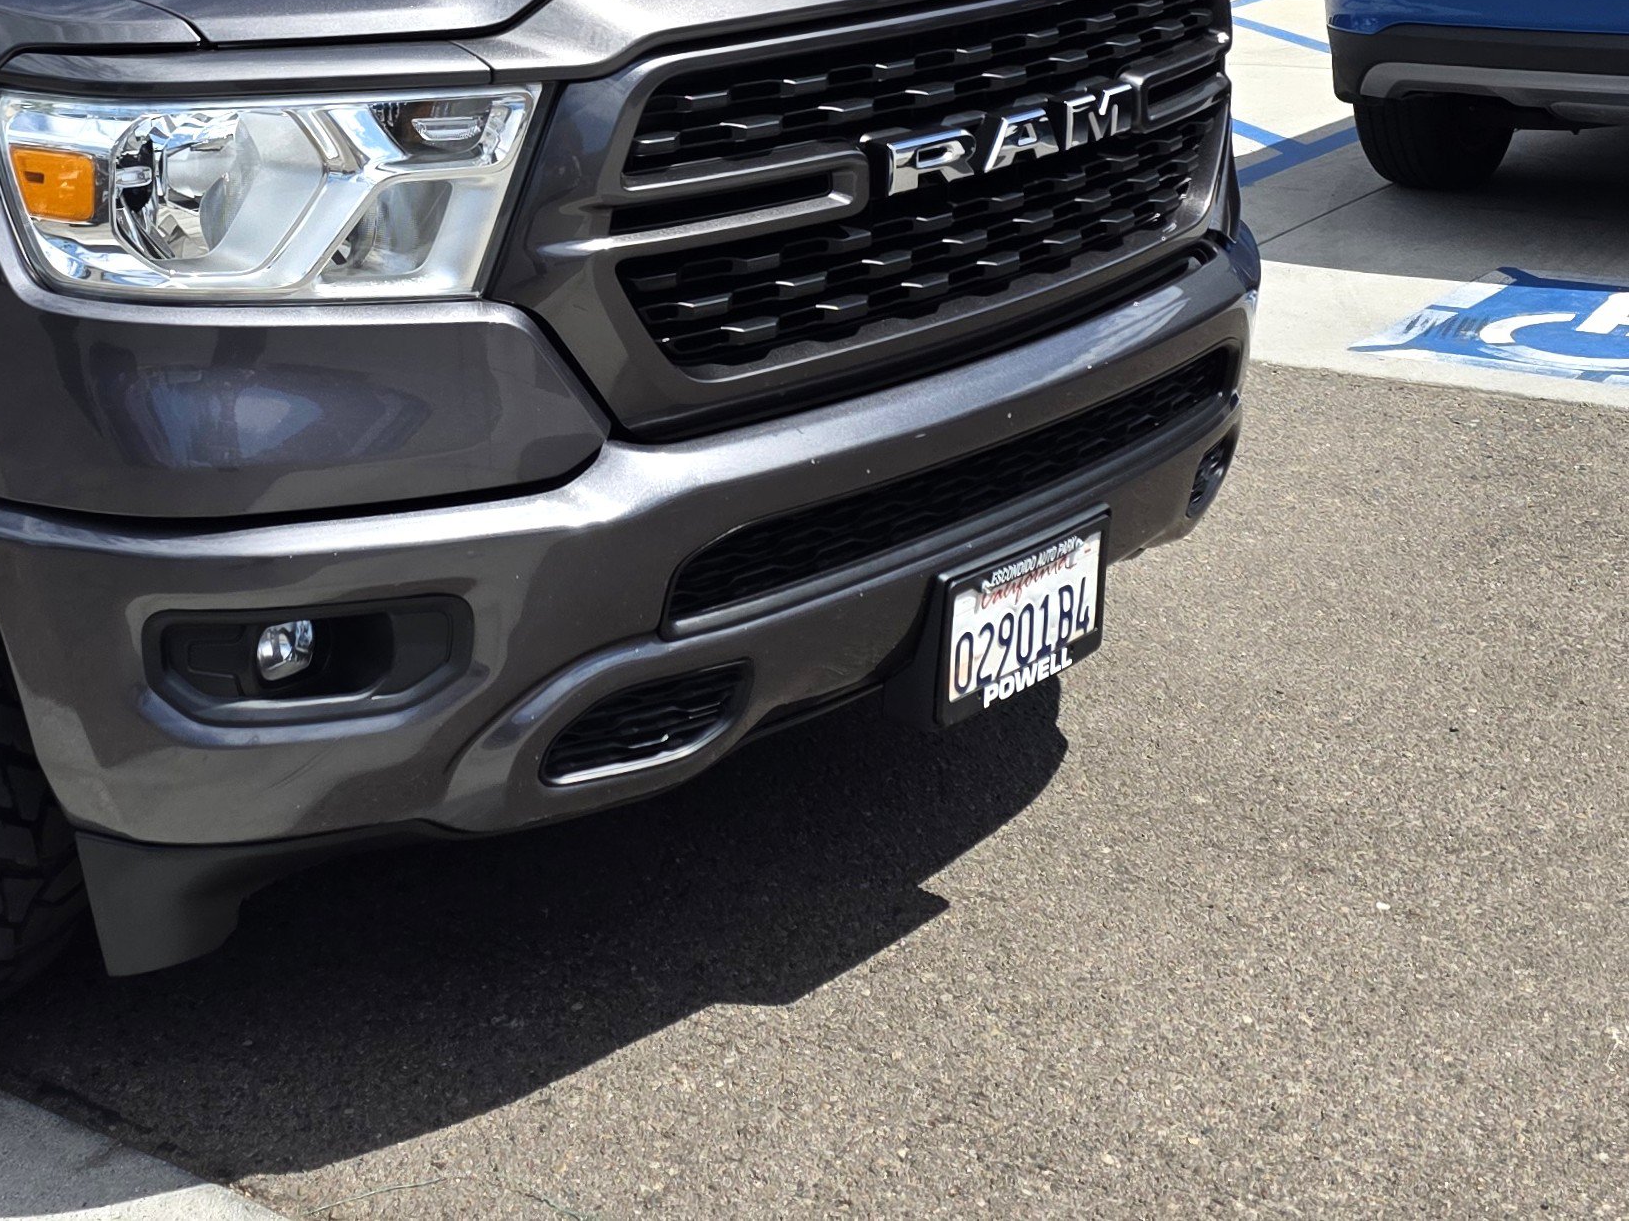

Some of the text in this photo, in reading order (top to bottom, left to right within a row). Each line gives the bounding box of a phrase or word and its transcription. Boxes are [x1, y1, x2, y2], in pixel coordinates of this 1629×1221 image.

[886, 83, 1133, 197] RAM
[991, 555, 1037, 587] ESCONDIDO
[1036, 545, 1058, 569] AUTO
[954, 576, 1090, 694] 02901B4
[983, 647, 1073, 709] POWELL
